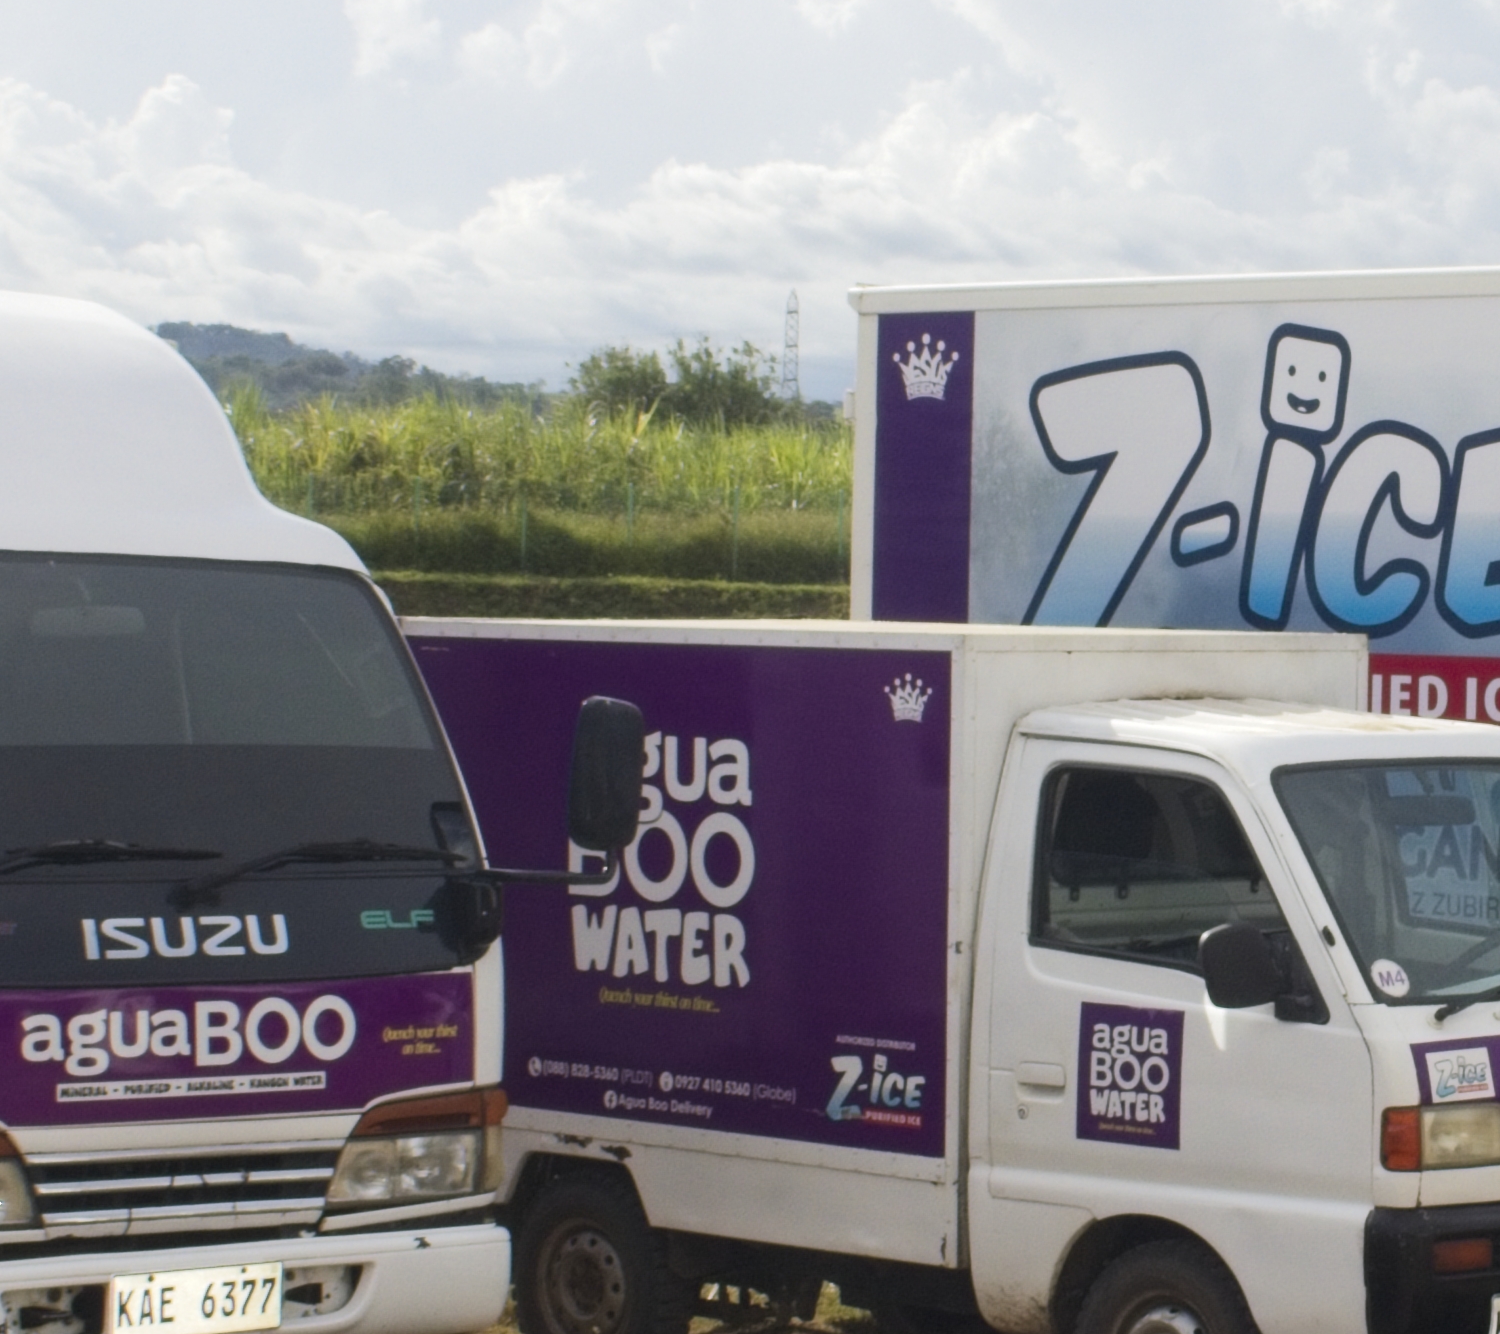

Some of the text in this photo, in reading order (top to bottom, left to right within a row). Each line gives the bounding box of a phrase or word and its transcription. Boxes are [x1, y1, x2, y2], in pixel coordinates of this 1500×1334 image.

[81, 913, 290, 961] ISUZU
[360, 909, 434, 929] ELF
[571, 904, 751, 988] WATER
[1378, 970, 1406, 988] M4
[21, 994, 357, 1077] aguaBOO
[1092, 1022, 1168, 1059] agua
[674, 1074, 701, 1091] 0927
[702, 1078, 723, 1094] 410
[724, 1080, 750, 1098] 5360
[1090, 1050, 1170, 1093] BOO
[618, 1093, 714, 1119] Agua Boo Delivery
[865, 1110, 922, 1126] PURIFIED ICE
[1089, 1088, 1166, 1124] WATER
[117, 1277, 276, 1328] KAE 6377
